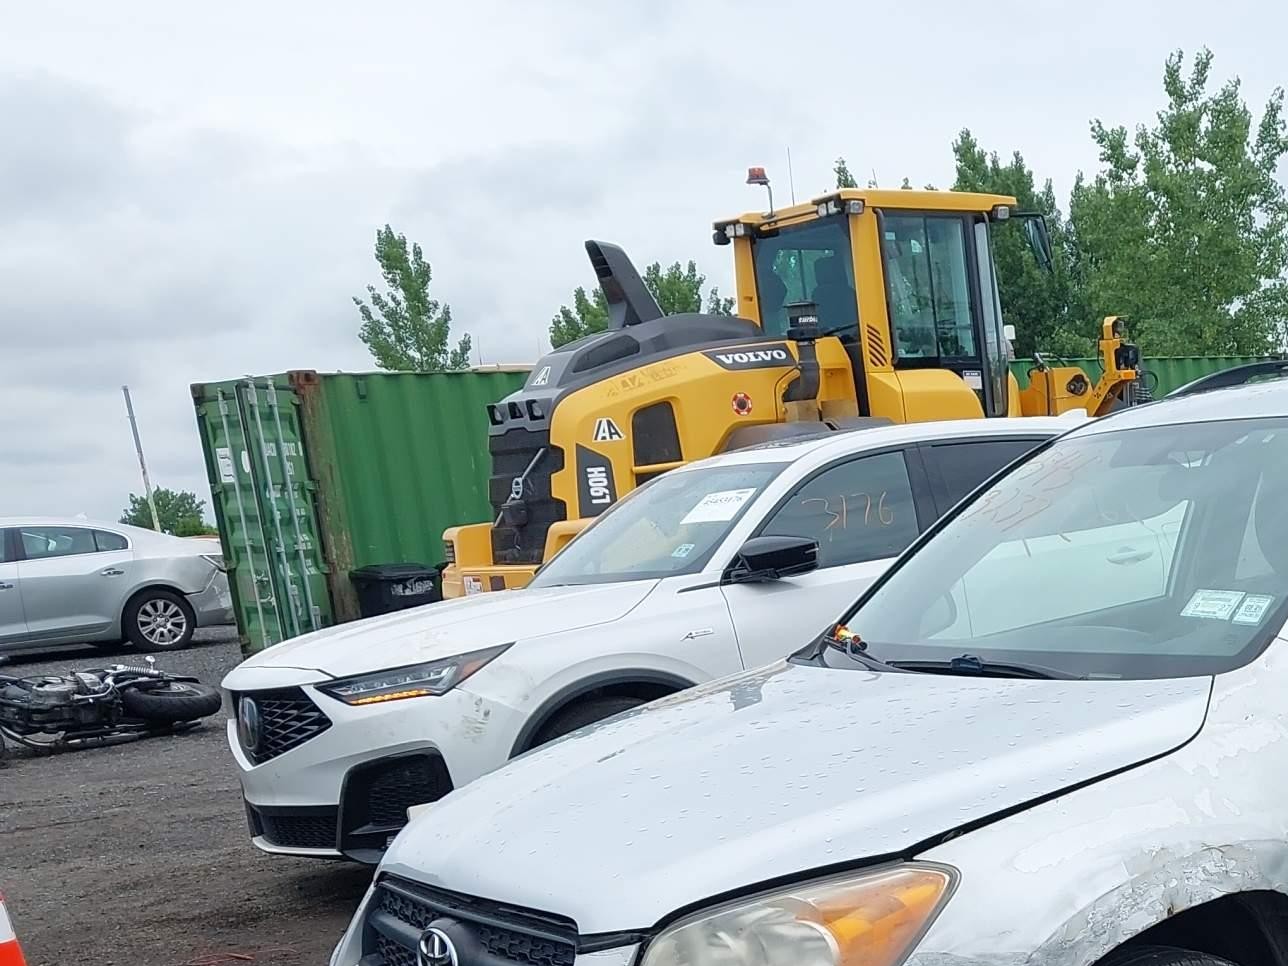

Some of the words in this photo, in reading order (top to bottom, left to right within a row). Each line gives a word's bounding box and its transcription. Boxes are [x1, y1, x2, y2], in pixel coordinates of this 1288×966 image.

[716, 349, 787, 364] VOLVO
[586, 466, 611, 504] L90H
[801, 491, 894, 531] 3176
